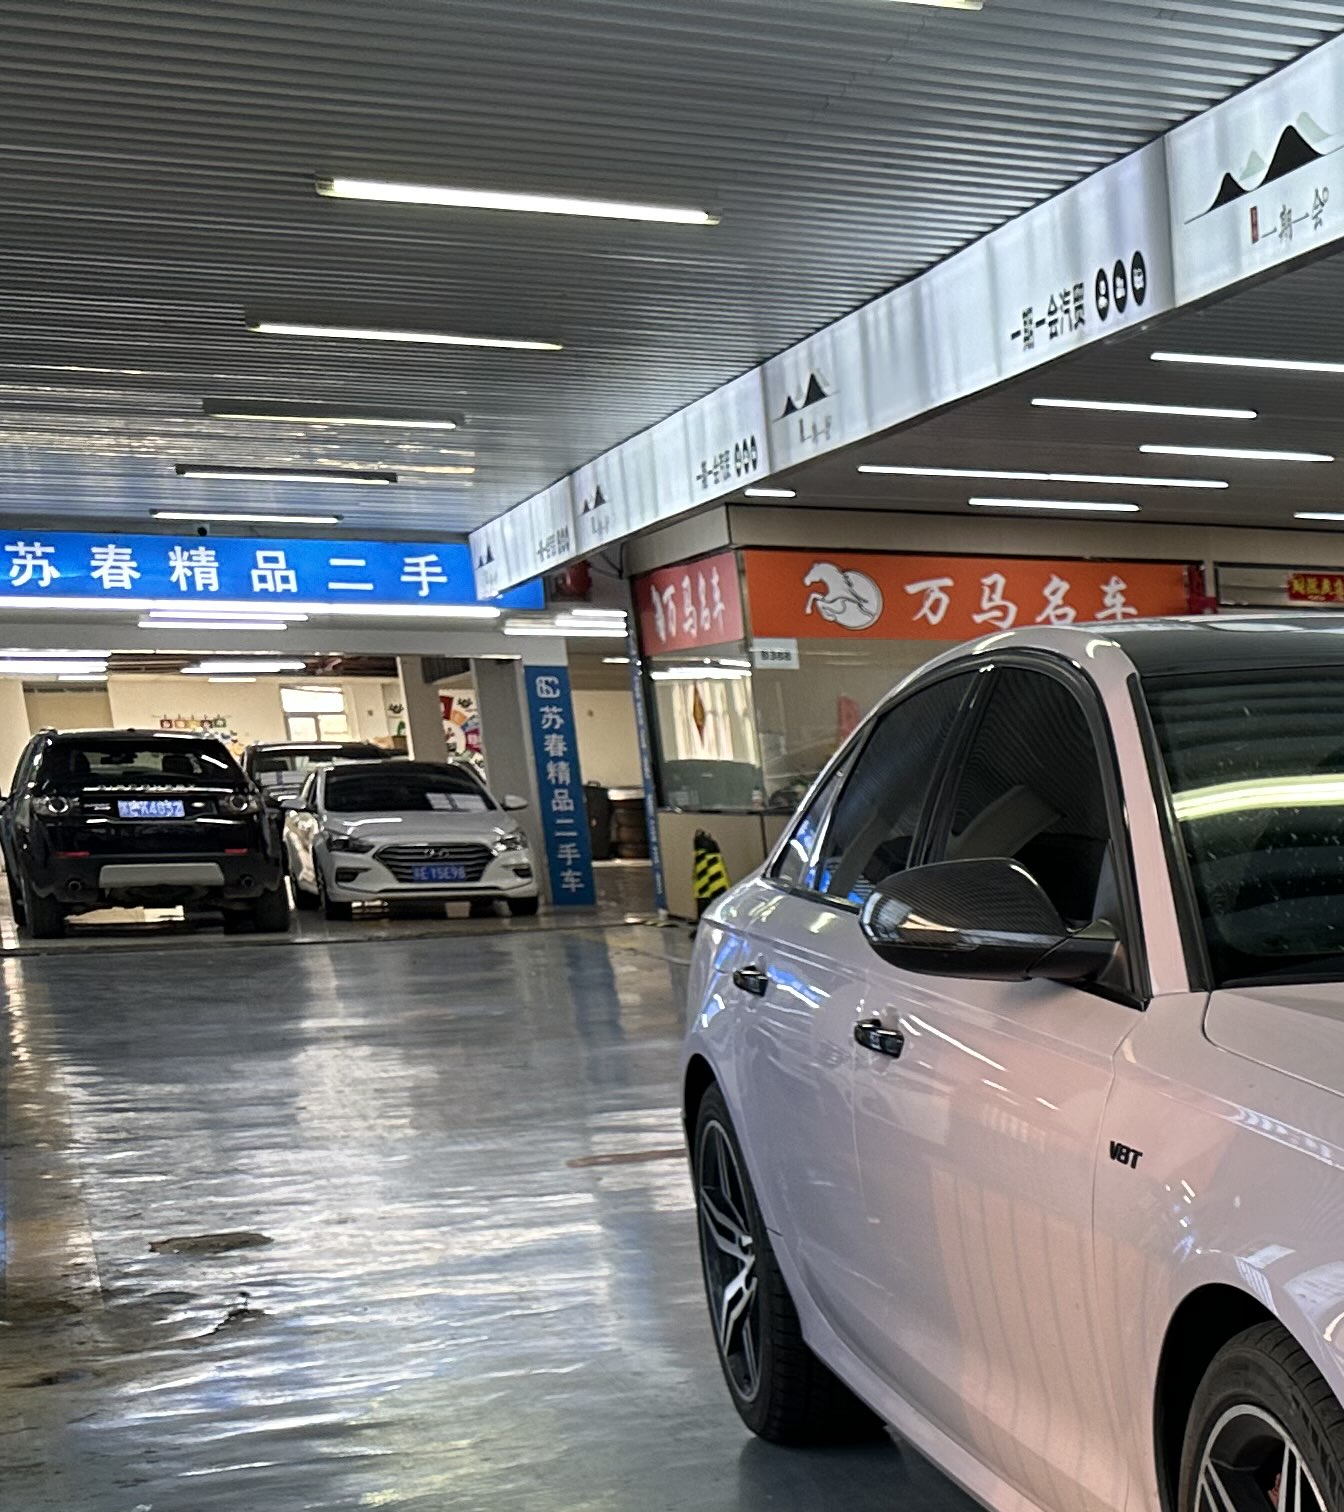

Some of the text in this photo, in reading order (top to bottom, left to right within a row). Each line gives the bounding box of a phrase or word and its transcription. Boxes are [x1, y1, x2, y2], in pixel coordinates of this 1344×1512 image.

[904, 572, 1138, 629] 万马名车
[539, 705, 584, 892] 苏春精品二手车
